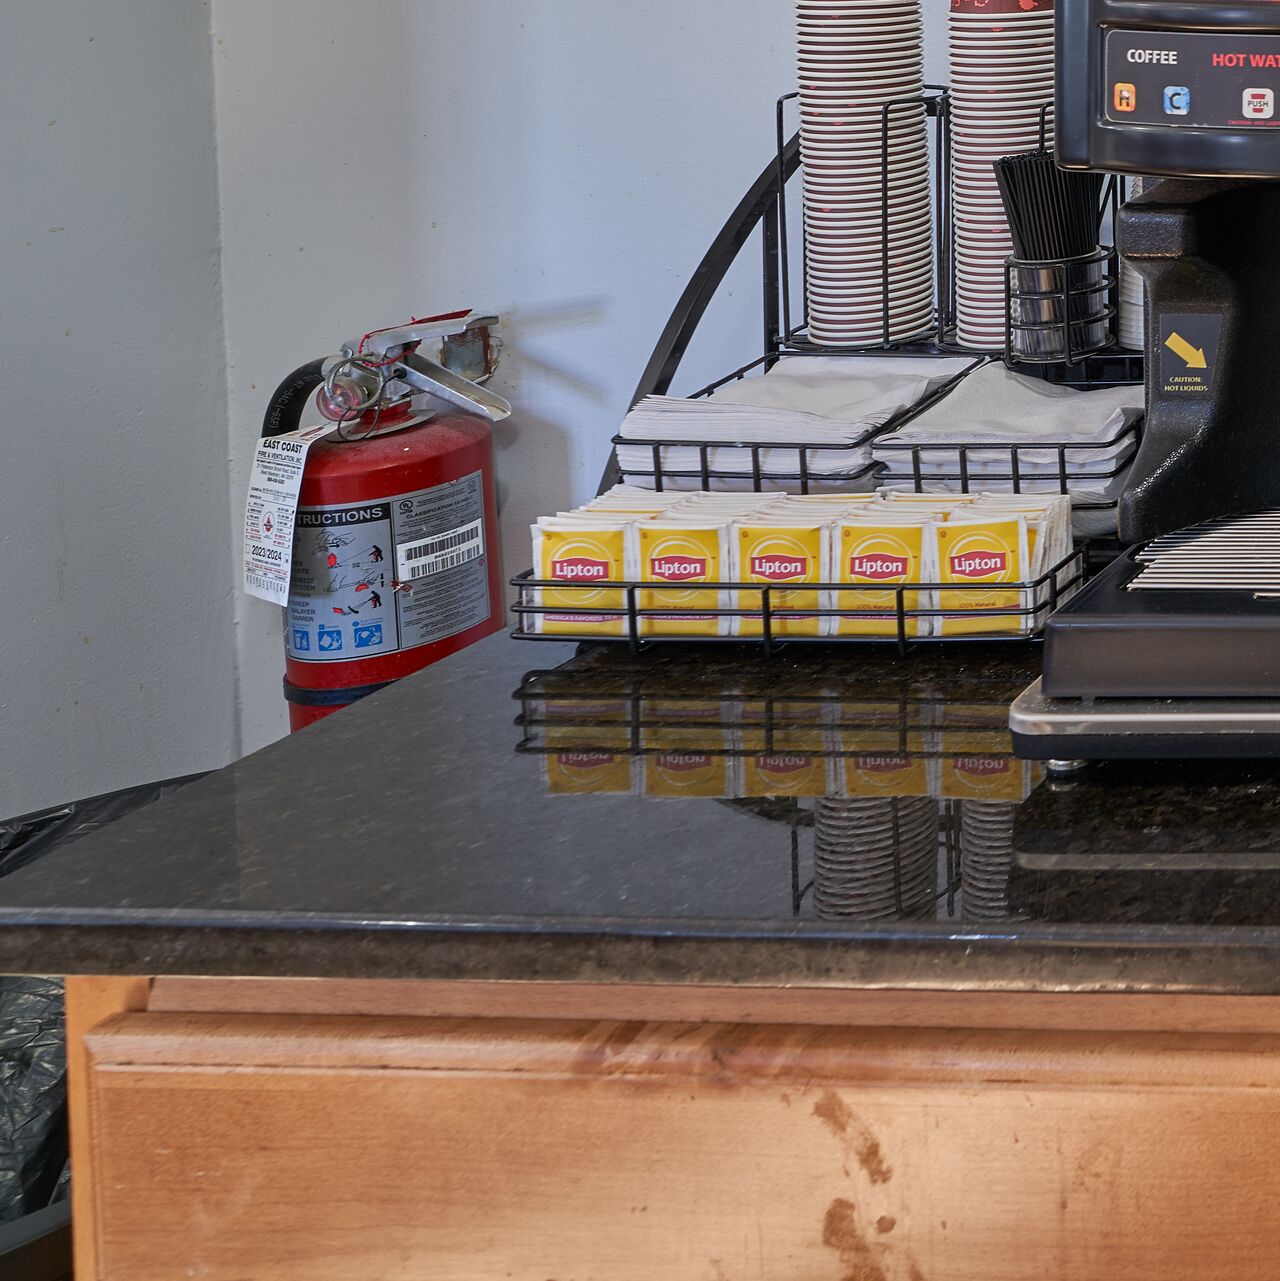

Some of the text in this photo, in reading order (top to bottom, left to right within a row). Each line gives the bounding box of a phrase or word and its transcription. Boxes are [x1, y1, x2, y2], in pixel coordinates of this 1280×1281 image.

[1126, 49, 1178, 65] COFFEE
[1212, 53, 1247, 67] HOT
[1169, 92, 1182, 109] C
[263, 439, 302, 454] EAST COAST
[296, 507, 383, 525] TRUCTIONS
[555, 562, 604, 578] Lipton
[654, 560, 701, 576] Lipton
[754, 559, 802, 575] Lipton
[854, 559, 902, 575] Lipton
[954, 557, 1001, 573] Lipton
